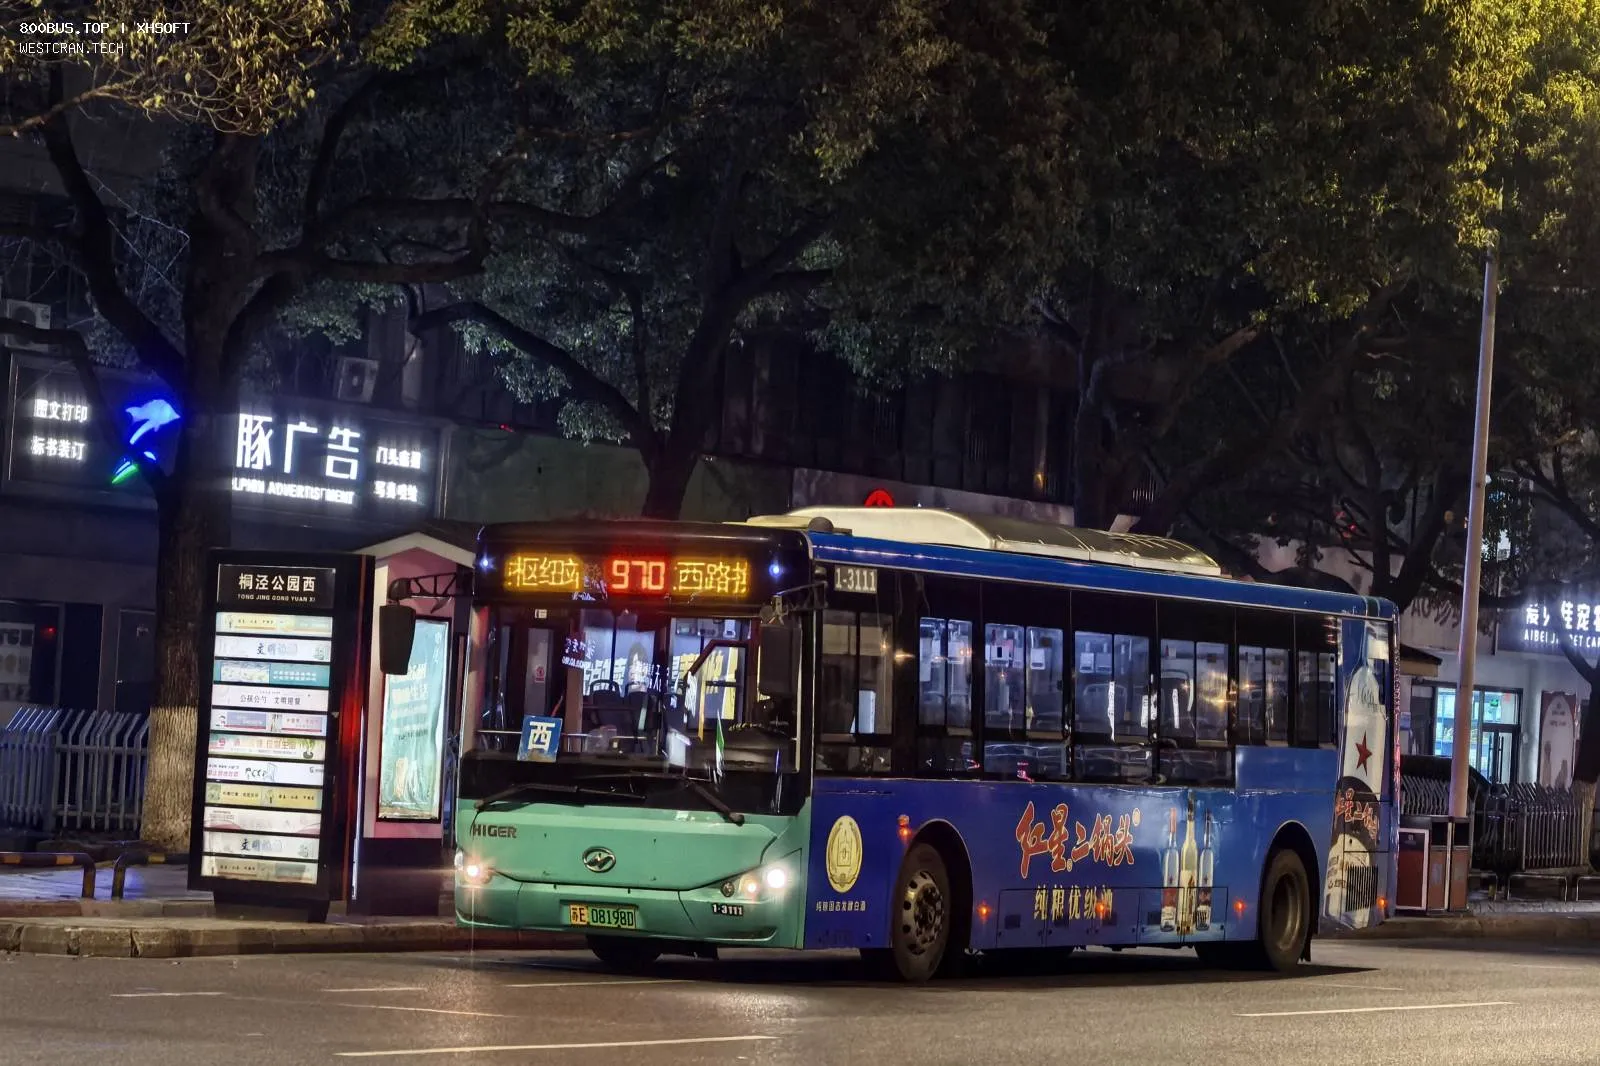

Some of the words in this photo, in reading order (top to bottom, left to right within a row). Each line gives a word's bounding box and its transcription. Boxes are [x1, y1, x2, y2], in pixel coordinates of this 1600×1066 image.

[33, 398, 89, 424] 图文打印
[31, 436, 86, 461] 标书装订
[238, 572, 317, 592] 桐泾公园西
[611, 560, 666, 590] 970
[834, 567, 877, 593] 1-3111
[237, 593, 255, 601] TONG
[1524, 628, 1549, 644] AIBEI
[528, 720, 556, 749] 西
[472, 823, 517, 839] HIGER
[711, 902, 744, 917] 1-3111
